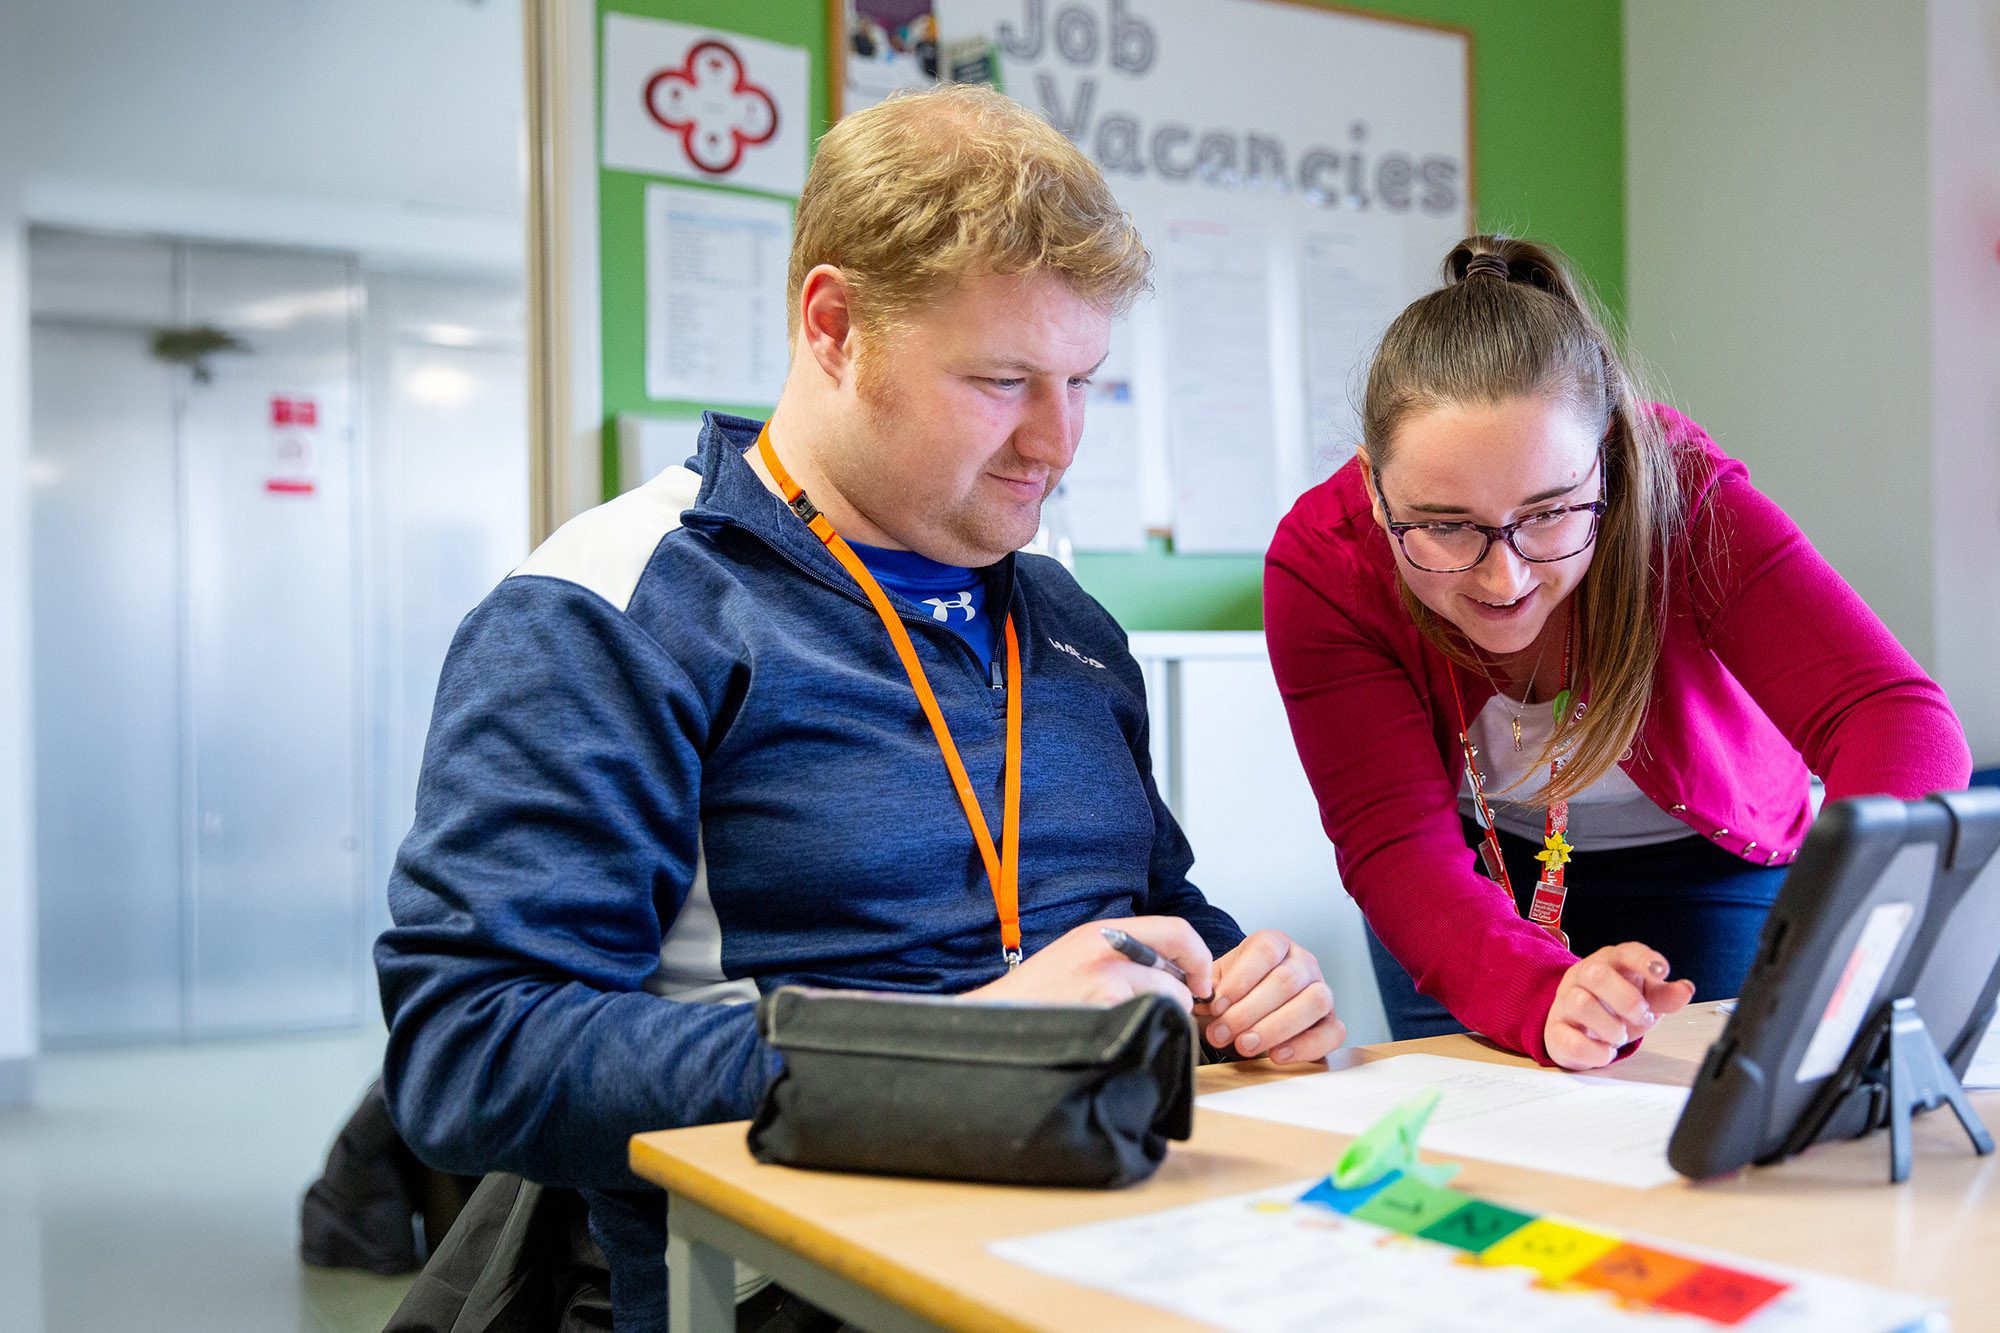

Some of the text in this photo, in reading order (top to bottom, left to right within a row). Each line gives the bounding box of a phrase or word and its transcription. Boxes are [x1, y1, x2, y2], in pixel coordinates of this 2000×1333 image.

[998, 0, 1157, 77] Job
[1036, 72, 1459, 213] Vacancies
[1382, 1197, 1423, 1216] 1
[1441, 1208, 1501, 1238] 2
